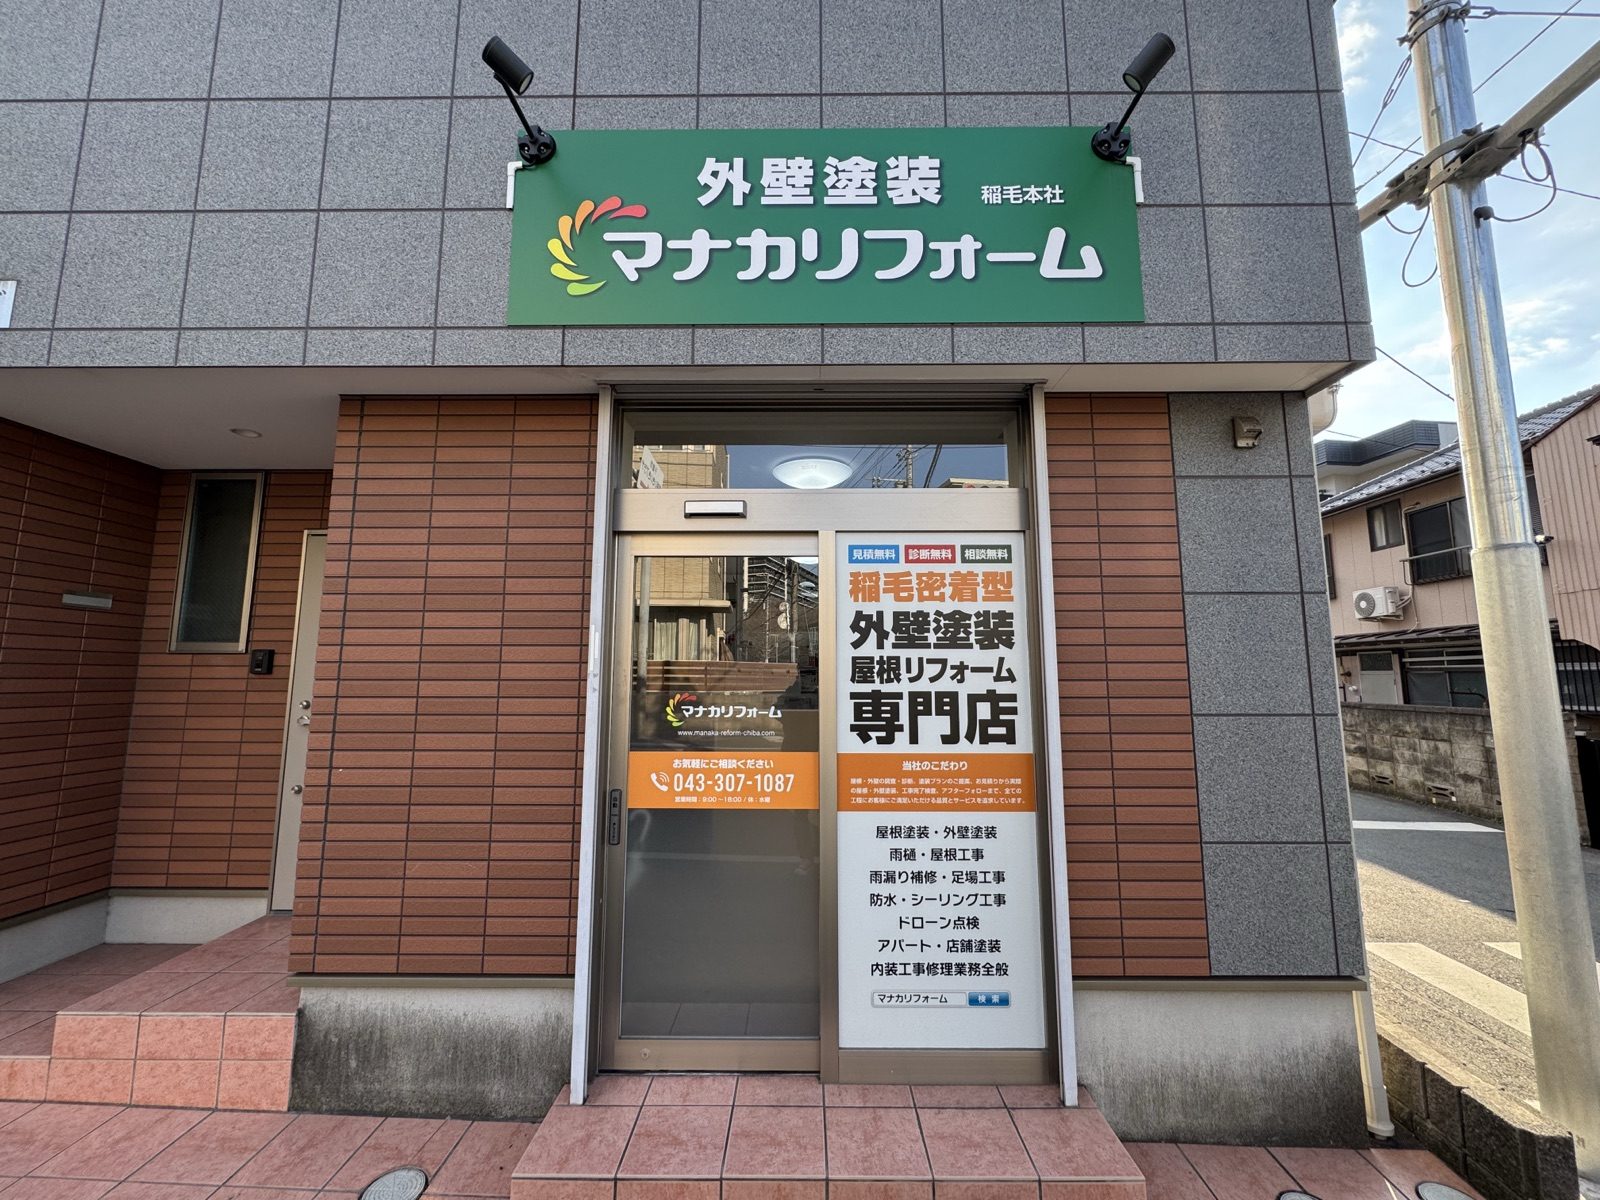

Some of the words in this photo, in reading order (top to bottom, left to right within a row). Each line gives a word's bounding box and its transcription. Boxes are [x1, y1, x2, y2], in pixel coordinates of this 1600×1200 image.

[697, 156, 942, 206] 外壁塗装
[981, 184, 1065, 205] 稲毛本社
[602, 226, 1104, 284] マナカリフォーム
[852, 548, 896, 560] 見積無料
[908, 548, 953, 560] 診断無料
[964, 548, 1009, 560] 相談無料
[849, 571, 1014, 603] 稲毛密着型
[849, 609, 1016, 651] 外壁塗装
[850, 655, 1017, 685] 屋根リフォーム
[681, 705, 782, 718] マナカリフォーム
[849, 689, 1018, 745] 専門店
[677, 729, 776, 737] www.manaka-reform-chiba.com
[672, 758, 774, 769] お気軽にご相談ください
[902, 760, 968, 771] 当社のこだわり
[673, 773, 795, 792] 043-307-1087
[875, 825, 998, 840] 屋根塗装・外壁塗装
[889, 847, 985, 862] 雨樋・屋根工事
[869, 870, 1006, 885] 雨漏り補修・足場工事
[869, 892, 1007, 908] 防水・シーリング工事
[899, 915, 980, 930] ドローン点検
[877, 938, 1002, 954] アパート・店舗塗装
[870, 961, 1009, 977] 内装工事修理業務全般
[877, 993, 948, 1004] マナカリフォーム
